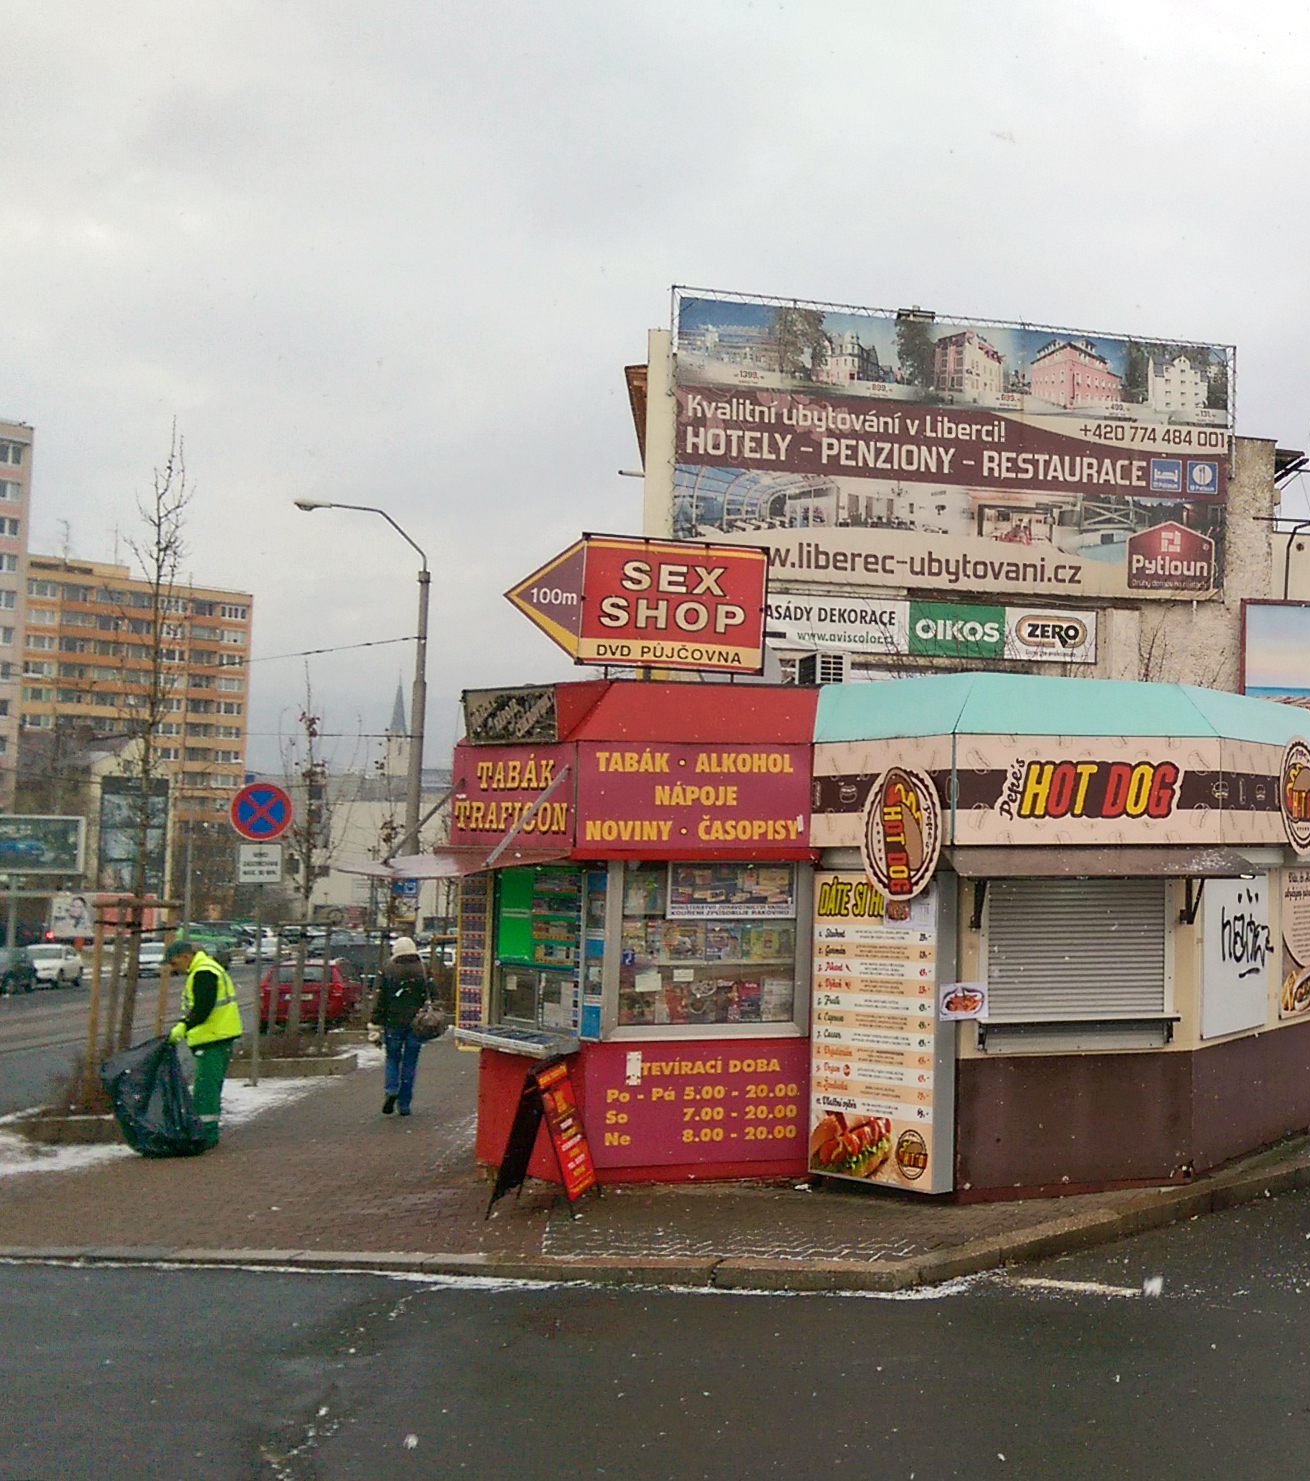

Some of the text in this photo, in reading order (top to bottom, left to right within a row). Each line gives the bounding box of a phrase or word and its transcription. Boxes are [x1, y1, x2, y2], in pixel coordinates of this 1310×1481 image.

[687, 394, 1006, 443] Kvalitní ubytování v Liberci!
[1079, 423, 1225, 448] +420 774 484 001
[686, 426, 793, 461] HOTELY
[821, 438, 956, 474] PENZIONY
[983, 450, 1147, 487] RESTAURACE
[769, 542, 1082, 585] w.liberec-ubytovani.cz
[1132, 554, 1208, 577] Pytloun
[620, 559, 728, 597] SEX
[530, 587, 578, 606] 100m
[598, 596, 746, 635] SHOP
[766, 601, 896, 626] ASÁDY DEKORACE
[914, 617, 1000, 642] OIKOS
[1027, 621, 1080, 648] ZERO
[596, 642, 742, 665] DVD PŮJČOVNA
[477, 753, 556, 791] TABÁK
[596, 748, 794, 774] TABÁK ALKOHOL
[655, 781, 738, 806] NÁPOJE
[1000, 758, 1178, 821] Pepe's HOT DOG
[585, 815, 799, 841] NOVINY ČASOPISY
[883, 805, 911, 893] HOT DOG
[818, 876, 852, 917] DÁTE
[852, 882, 868, 917] SI
[641, 1057, 781, 1076] TEVÍRACÍ DOBA
[606, 1089, 630, 1103] Po
[651, 1086, 676, 1101] Pá
[683, 1085, 725, 1100] 5.00
[745, 1083, 797, 1098] 20.00
[605, 1110, 628, 1125] So
[683, 1107, 724, 1121] 7.00
[744, 1104, 797, 1119] 20.00
[604, 1132, 631, 1146] Ne
[682, 1127, 724, 1142] 8.00
[744, 1124, 797, 1140] 20.00
